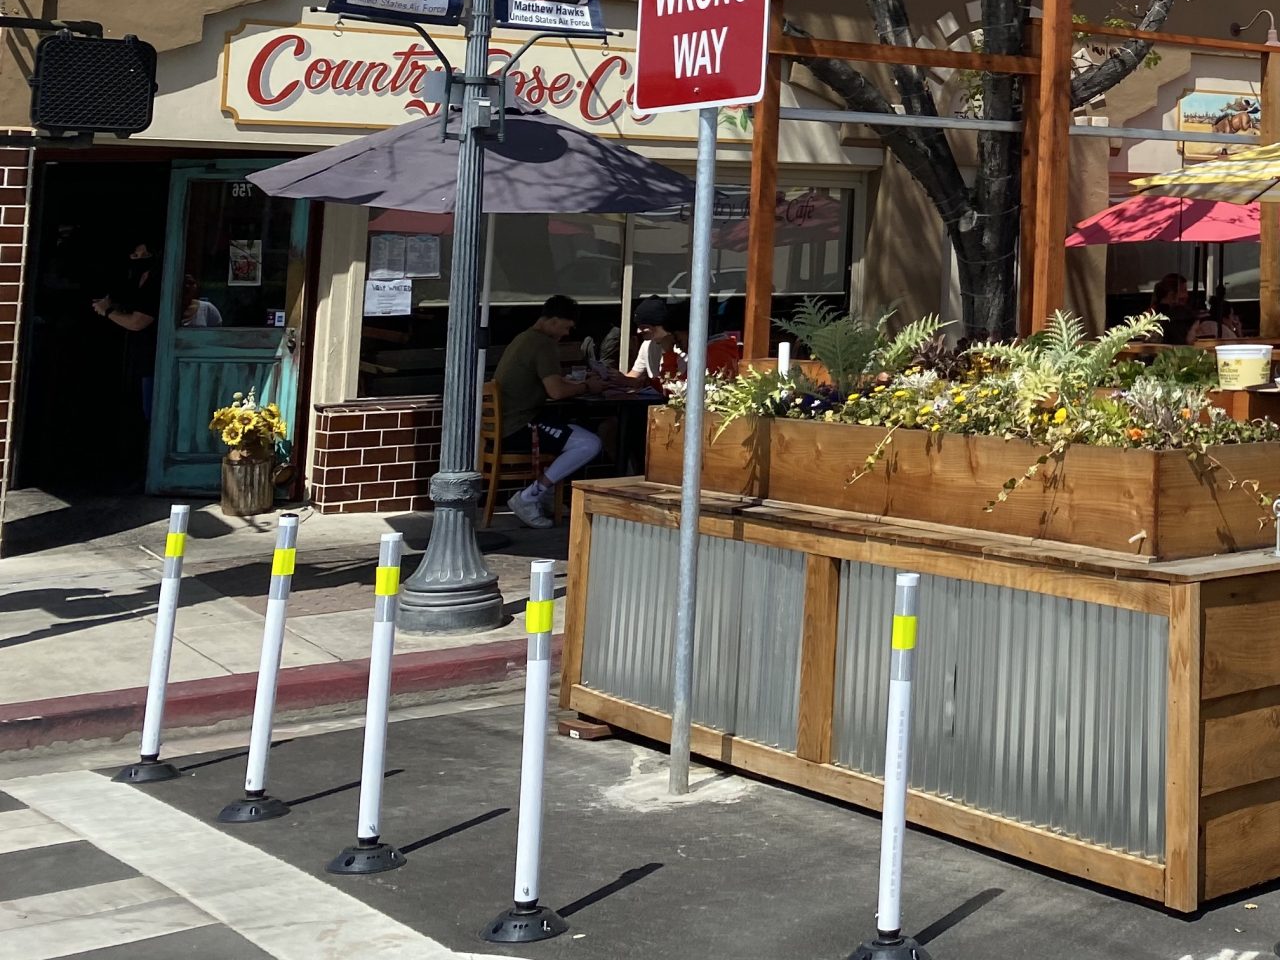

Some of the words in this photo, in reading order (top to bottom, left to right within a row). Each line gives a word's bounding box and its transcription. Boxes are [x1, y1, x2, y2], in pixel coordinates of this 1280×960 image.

[409, 2, 420, 10] Air
[423, 3, 447, 13] Force
[514, 1, 554, 14] Matthew
[555, 5, 585, 17] Hawks
[509, 13, 533, 23] United
[535, 15, 557, 25] States
[558, 17, 568, 25] Air
[570, 18, 590, 27] Force
[673, 26, 728, 79] WAY
